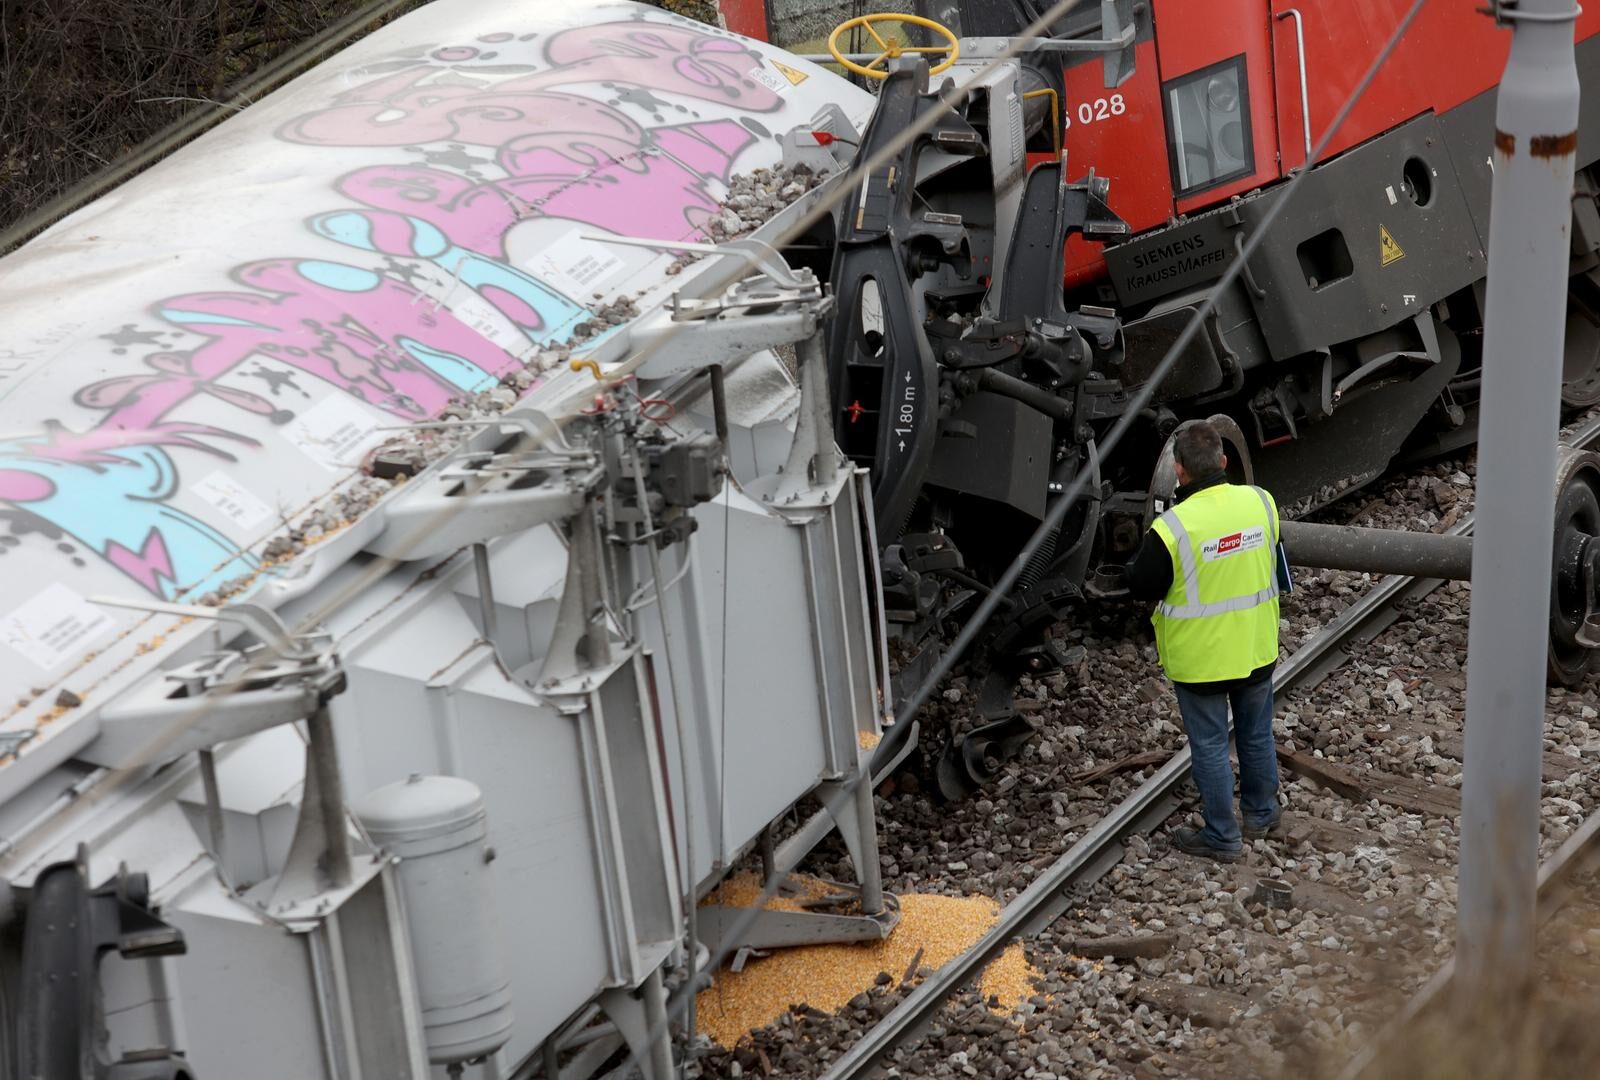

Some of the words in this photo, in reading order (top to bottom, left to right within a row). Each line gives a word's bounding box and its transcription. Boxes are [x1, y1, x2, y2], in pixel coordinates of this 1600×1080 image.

[1078, 93, 1126, 124] 028
[1133, 234, 1205, 269] SIEMENS
[904, 386, 916, 401] m
[895, 404, 914, 436] 1.80
[1203, 543, 1218, 553] Rail
[1219, 537, 1240, 549] Cargo
[1242, 531, 1262, 542] Carrier
